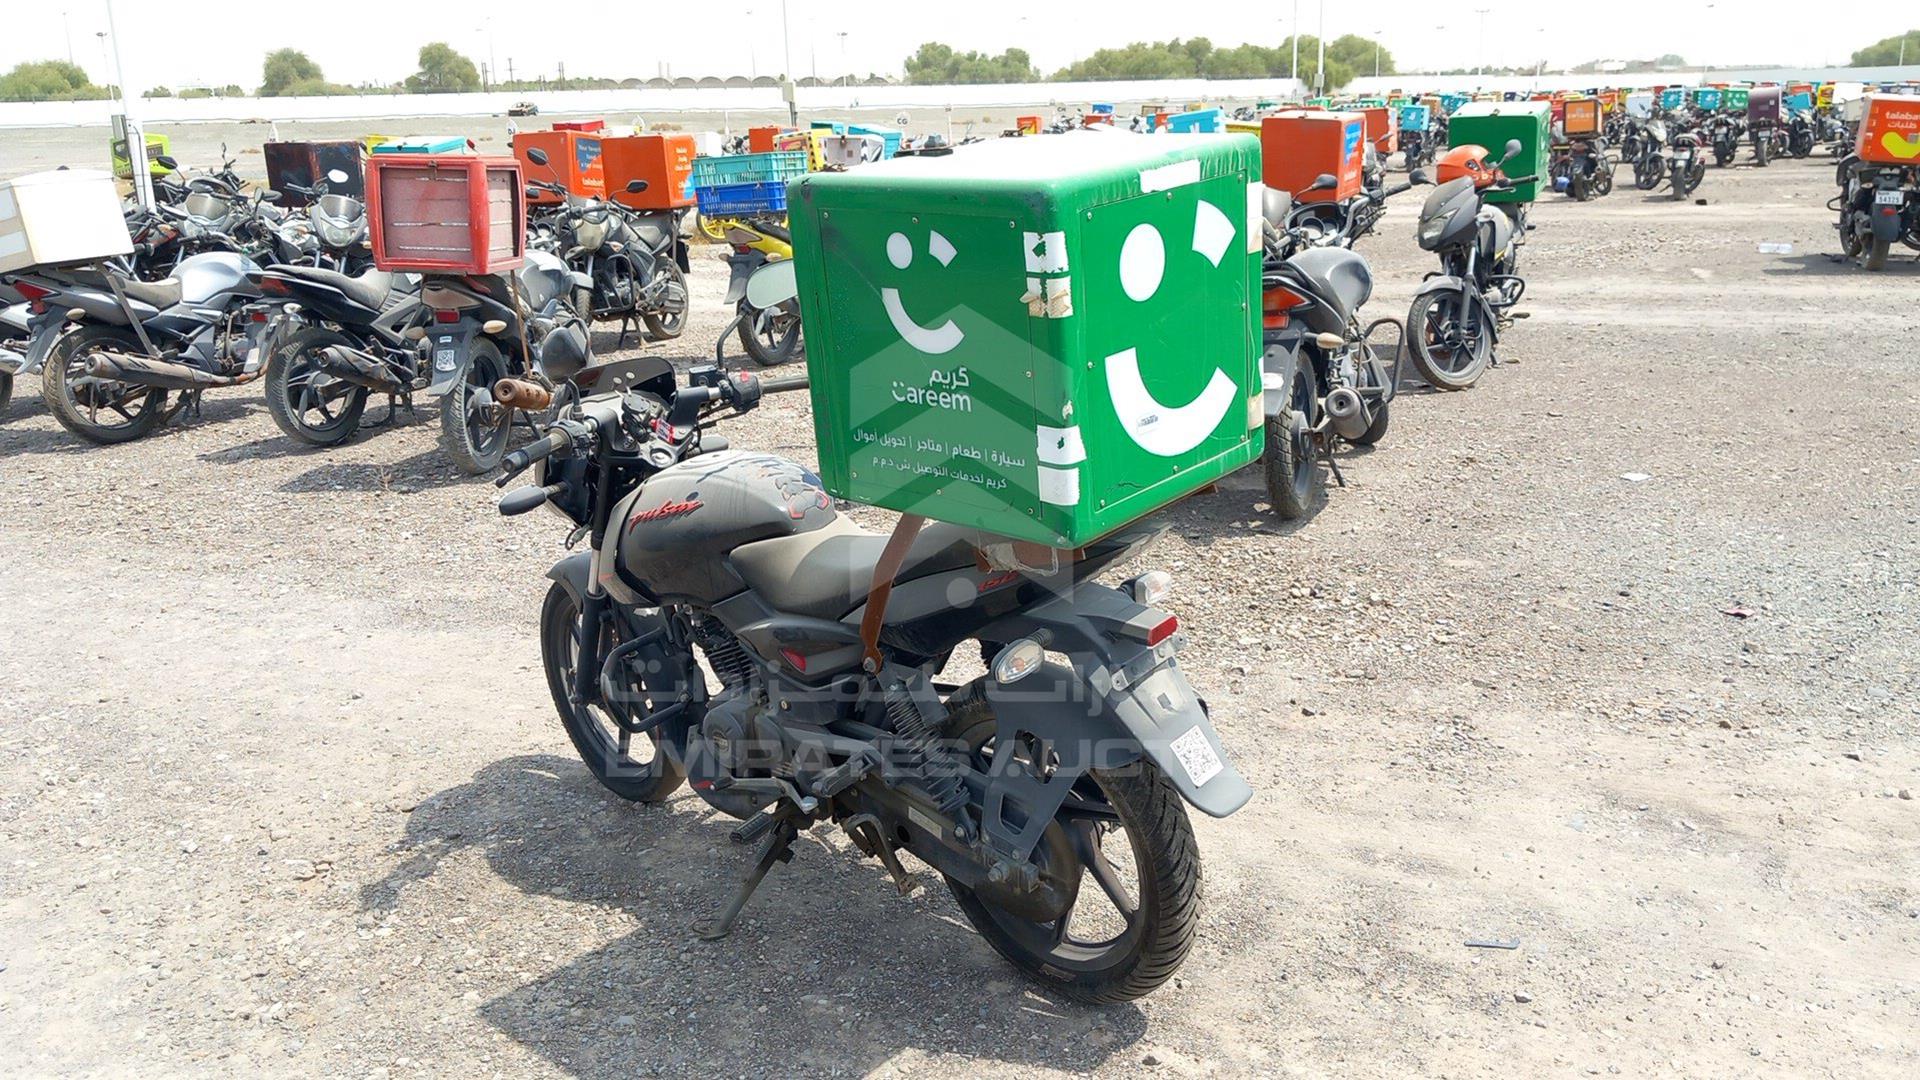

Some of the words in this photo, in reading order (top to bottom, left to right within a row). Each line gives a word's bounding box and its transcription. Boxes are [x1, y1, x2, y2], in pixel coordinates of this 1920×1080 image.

[1885, 110, 1920, 120] talaba
[929, 367, 969, 389] كريم
[880, 434, 906, 448] تحويل
[916, 438, 942, 453] متاجر
[952, 444, 982, 459] طعام
[991, 450, 1025, 467] سيارة
[912, 464, 948, 477] التوصيل
[949, 470, 984, 484] لخدمات
[985, 478, 1008, 490] كريم
